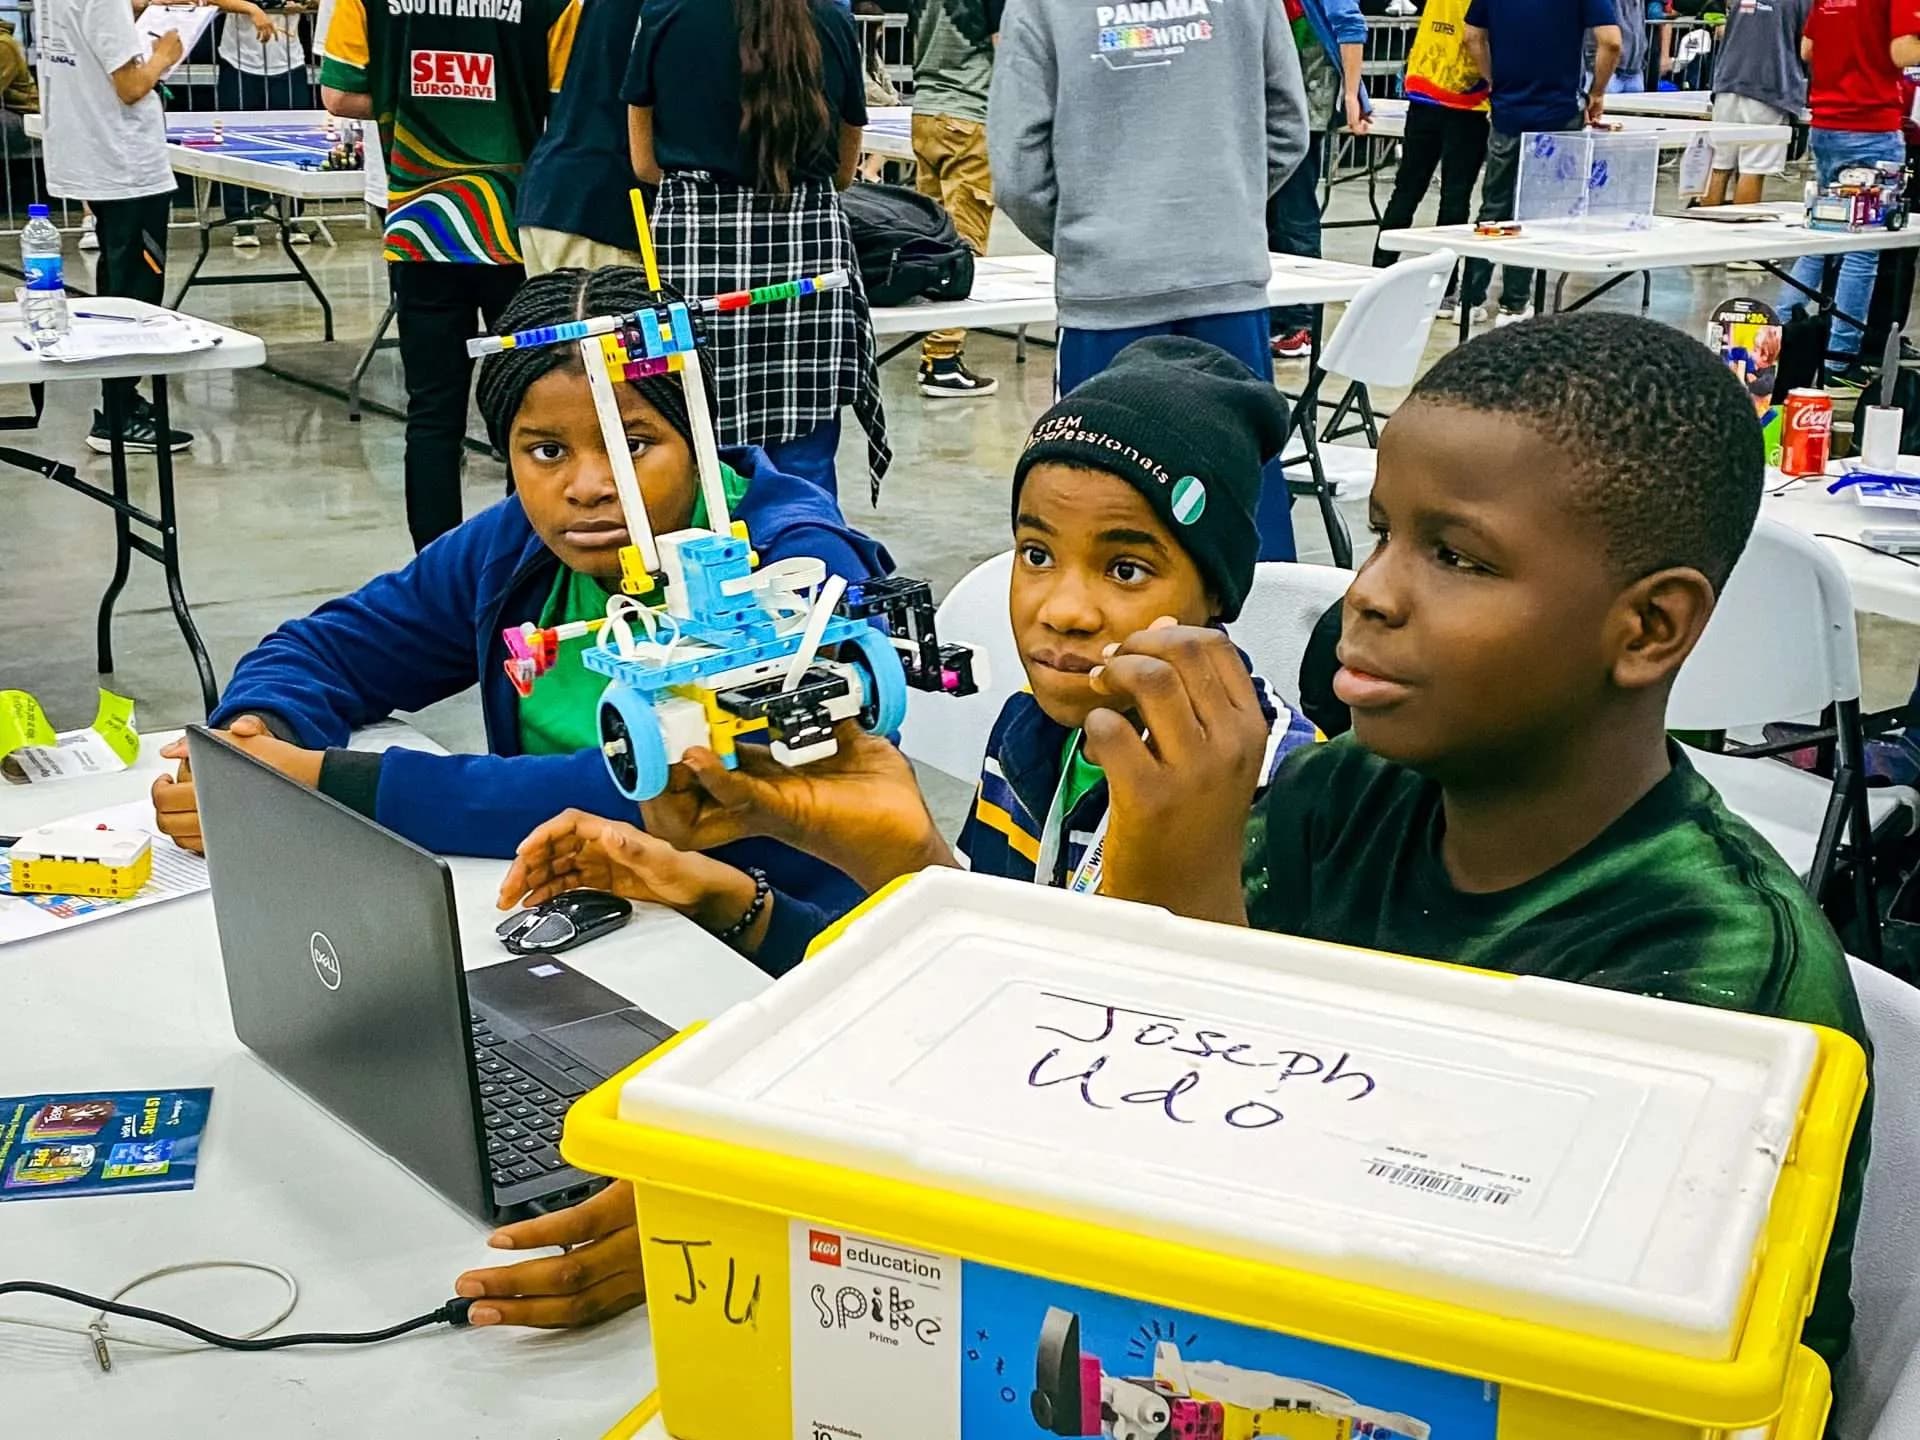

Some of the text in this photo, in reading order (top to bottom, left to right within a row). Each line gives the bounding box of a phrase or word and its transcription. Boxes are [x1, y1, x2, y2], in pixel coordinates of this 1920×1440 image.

[456, 0, 522, 24] AFRICA
[1097, 0, 1211, 26] PANAMA
[413, 52, 493, 85] SEW
[413, 83, 493, 98] EURODRIVE
[1035, 415, 1083, 437] STEM
[1035, 992, 1375, 1101] Joseph
[138, 1108, 159, 1135] Stand
[813, 1240, 941, 1280] LEGO education
[869, 1331, 899, 1346] Prime
